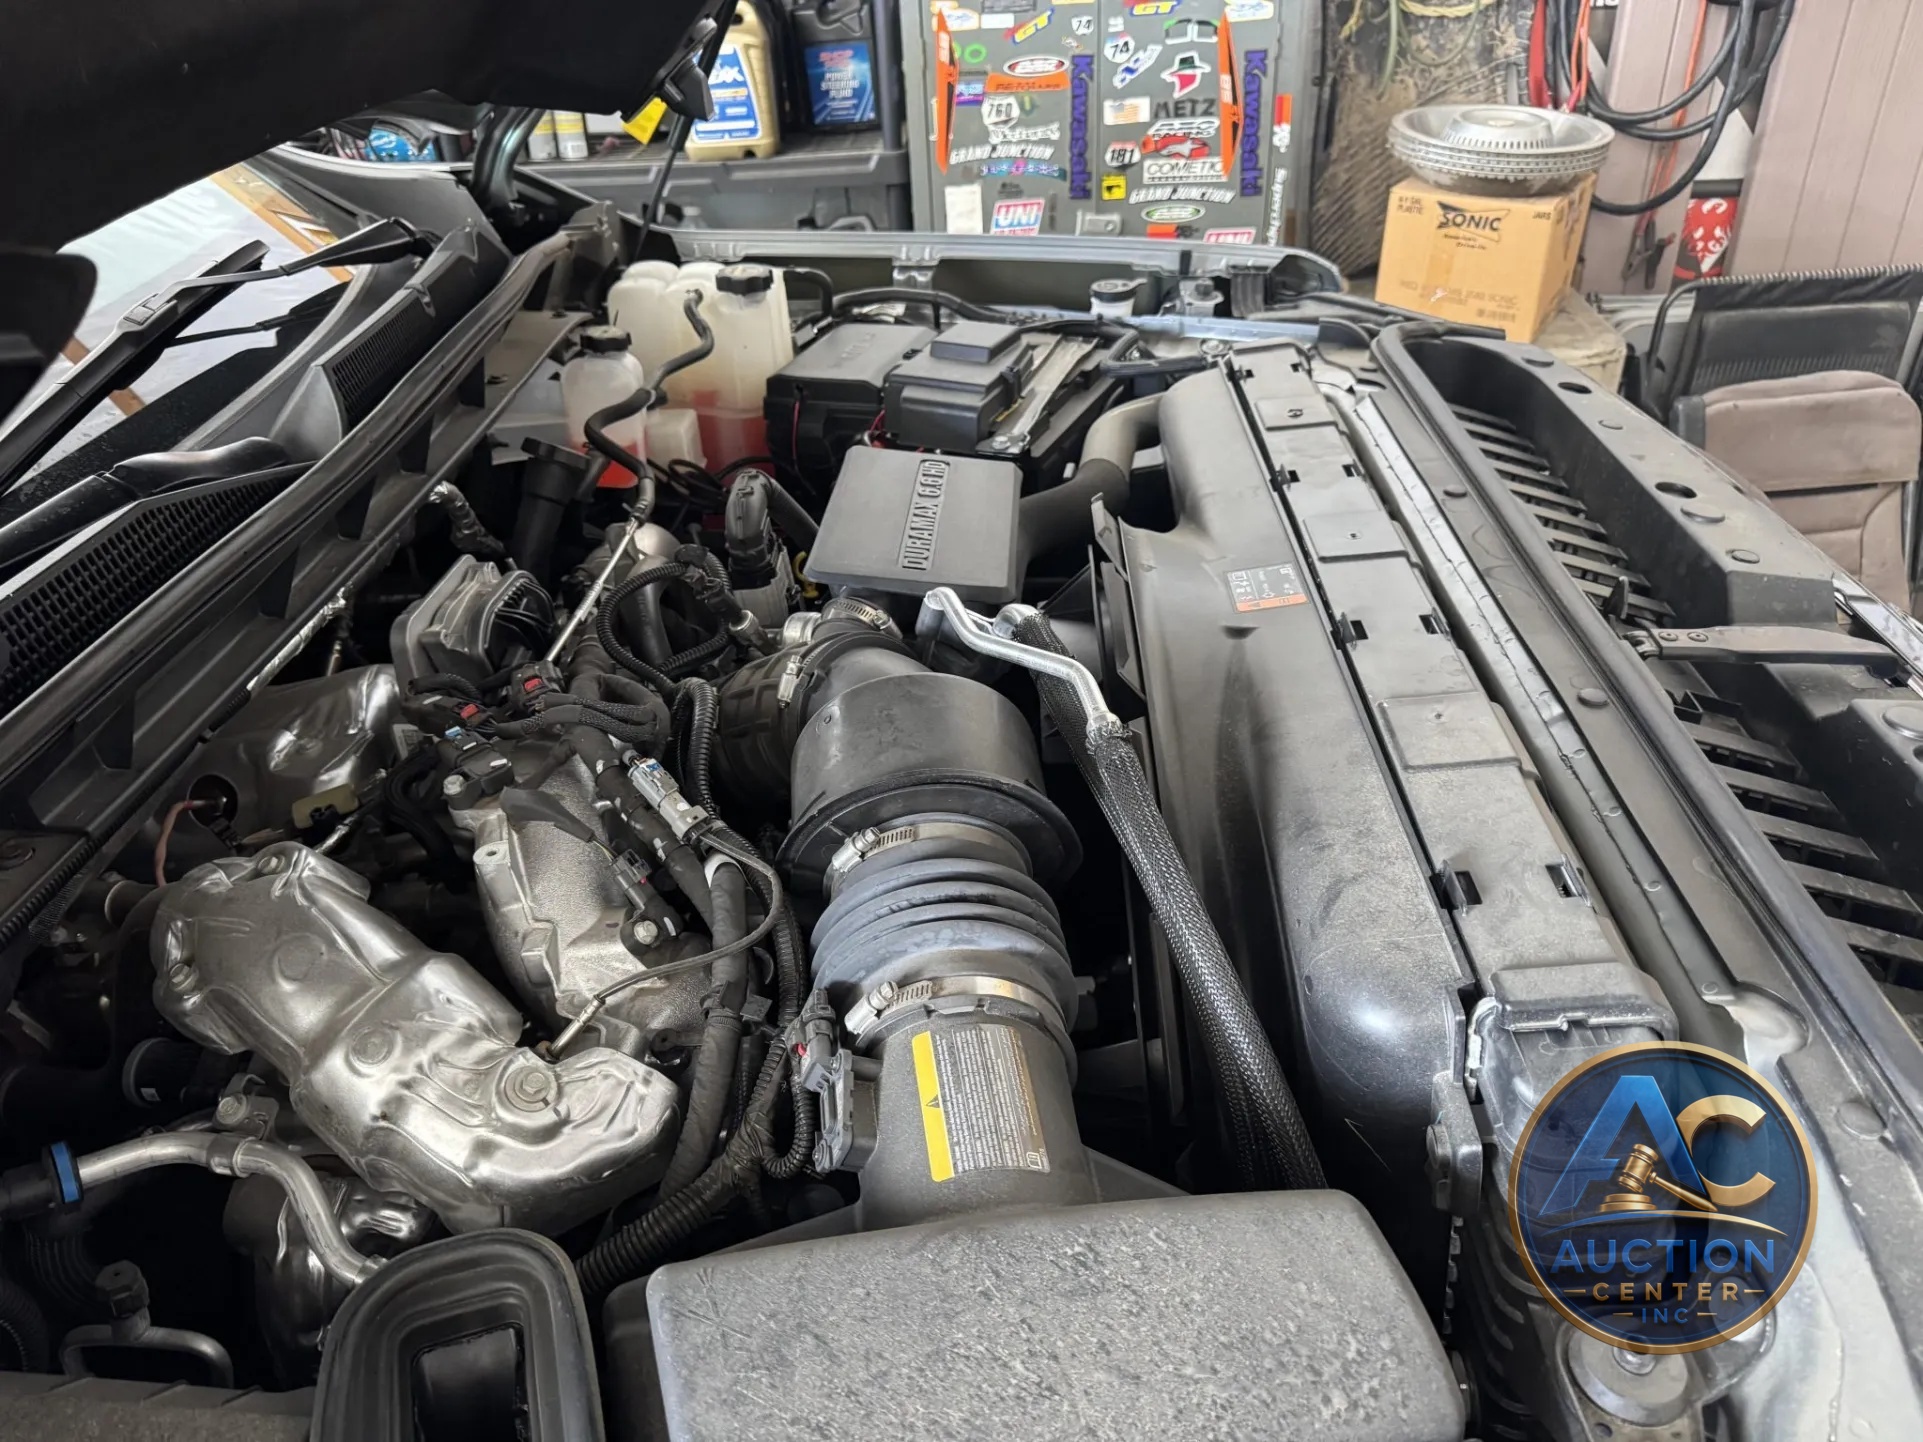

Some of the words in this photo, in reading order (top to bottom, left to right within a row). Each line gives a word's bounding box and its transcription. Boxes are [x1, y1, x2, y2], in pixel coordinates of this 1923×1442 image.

[1153, 99, 1215, 119] METZ
[1069, 55, 1095, 200] Kawasaki
[1240, 49, 1268, 196] Kawasaki
[949, 144, 992, 164] GRAND
[990, 143, 1055, 160] JUNCTION
[1128, 186, 1174, 204] GRAND
[1171, 186, 1236, 204] JUNCTION
[997, 203, 1039, 227] UNI
[1442, 212, 1502, 231] SONIC
[902, 501, 939, 571] DURAMAX
